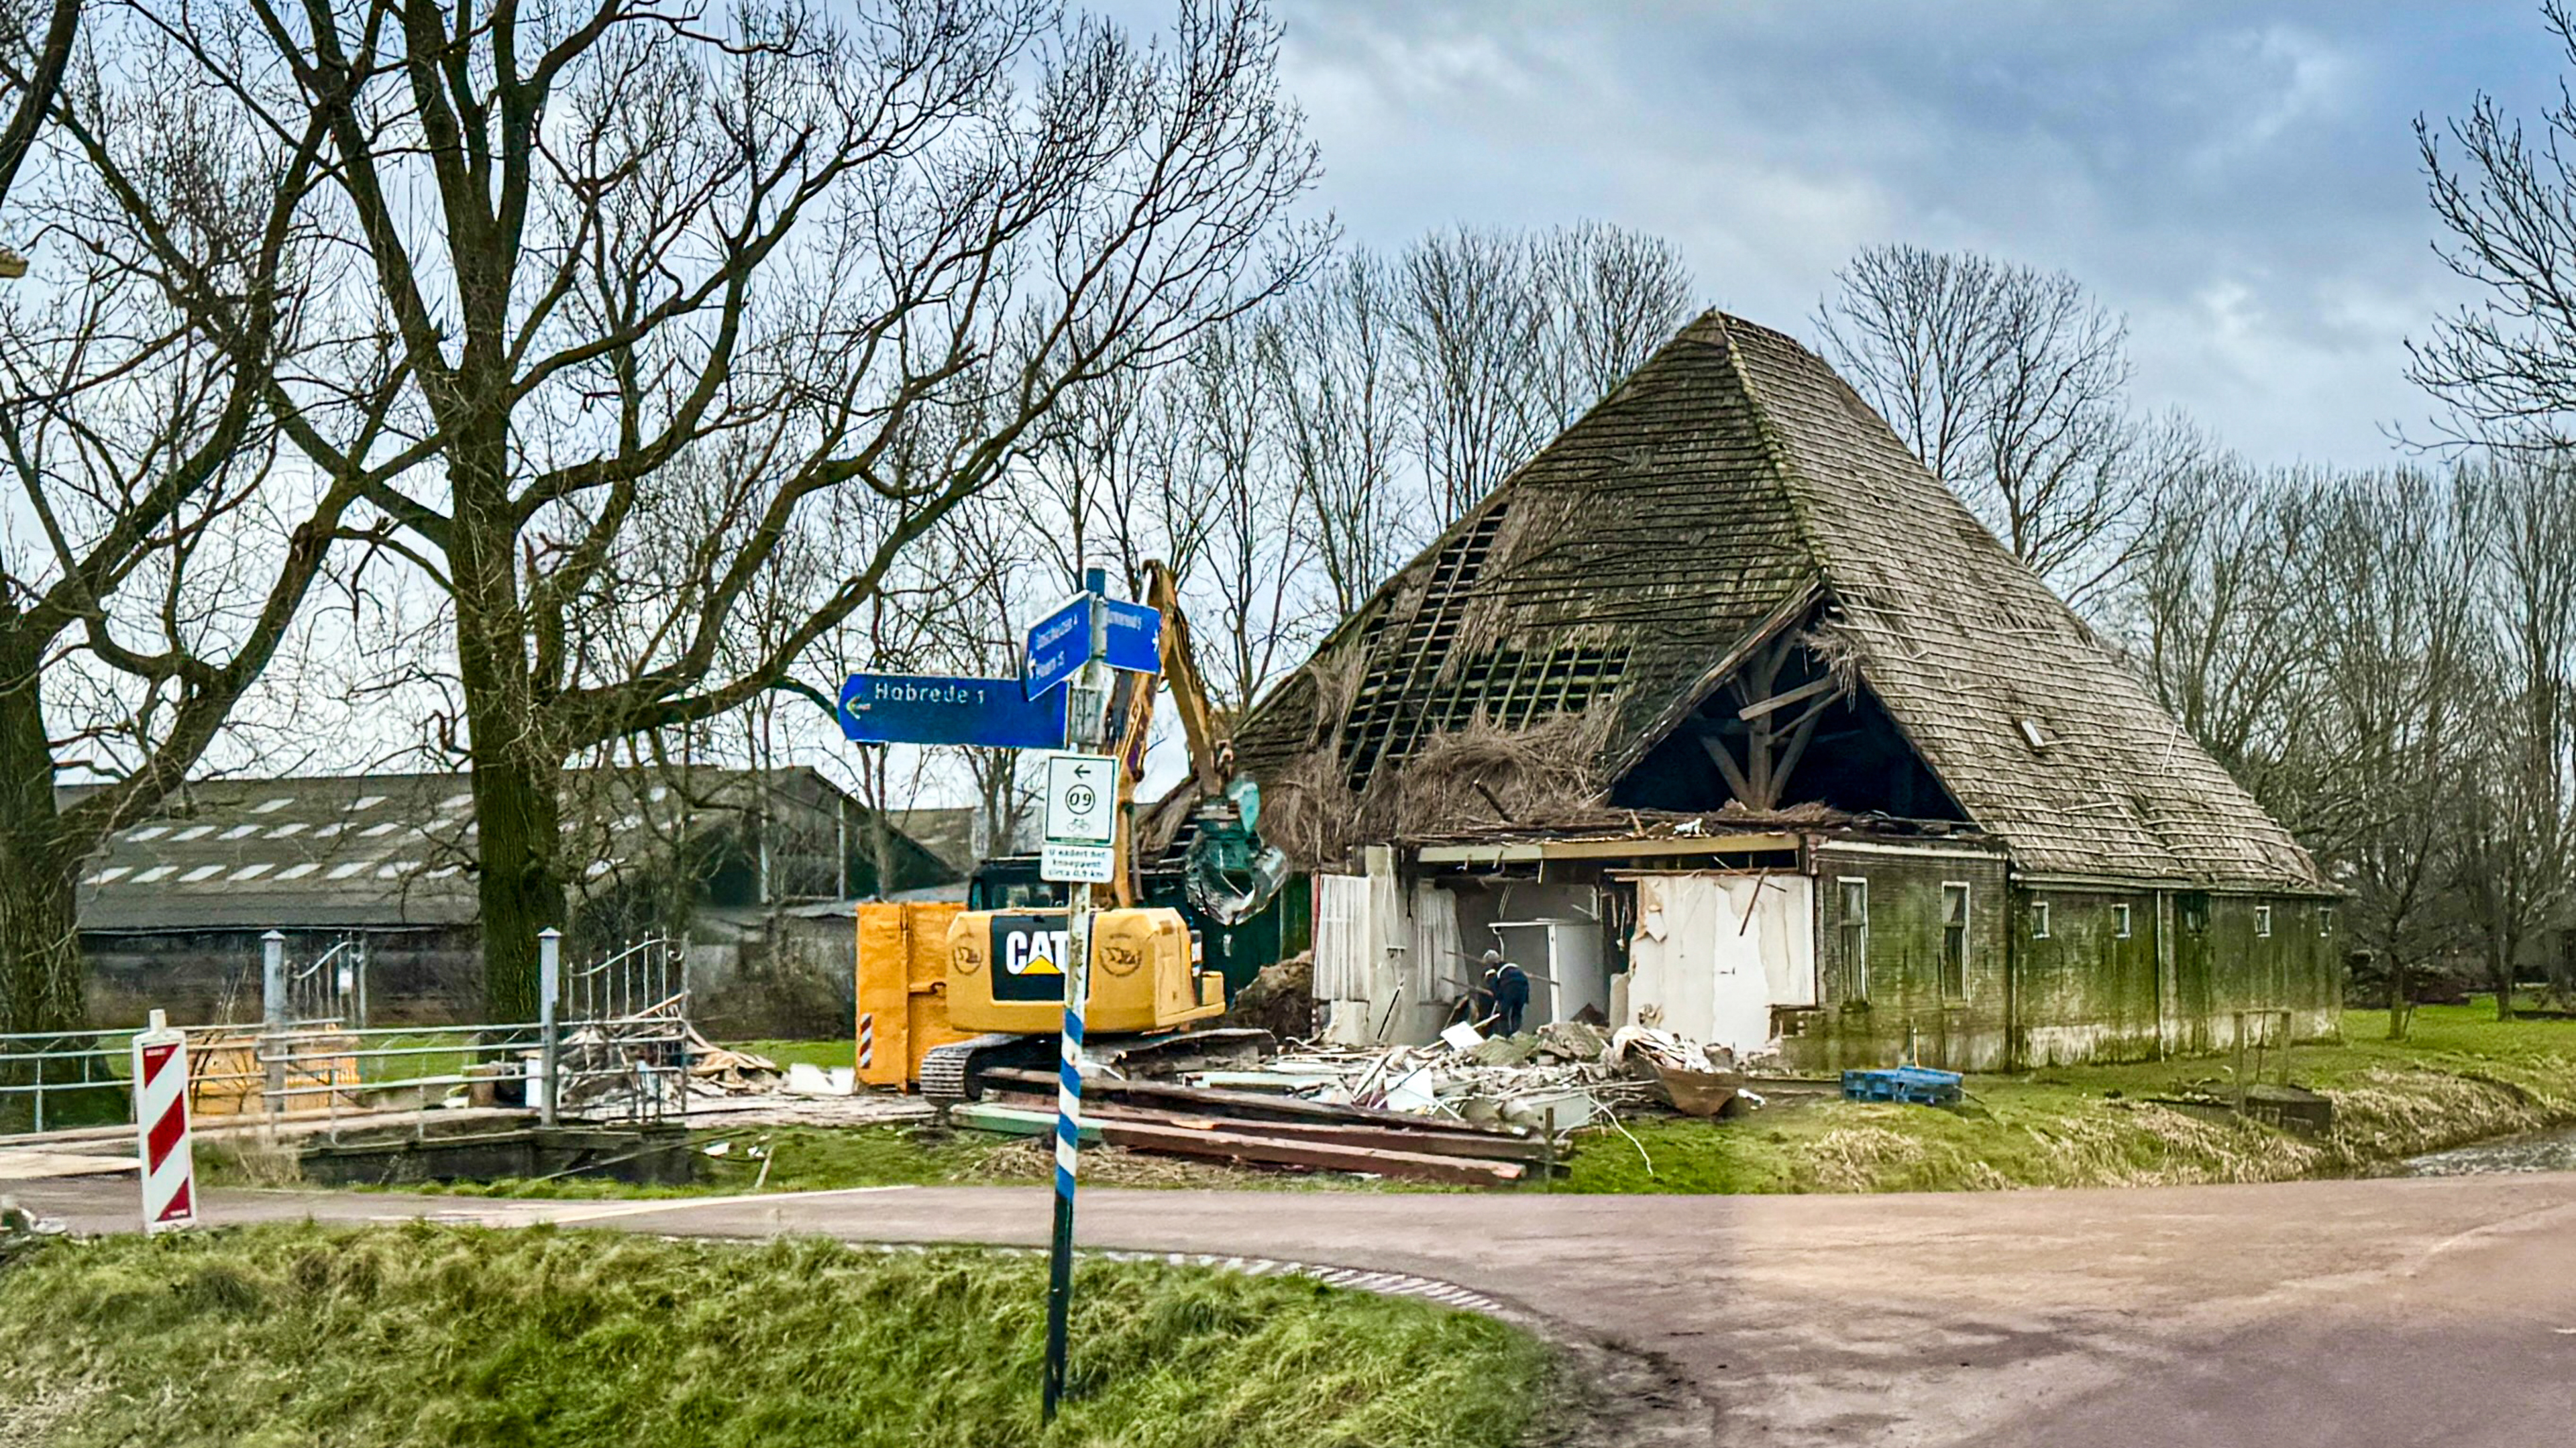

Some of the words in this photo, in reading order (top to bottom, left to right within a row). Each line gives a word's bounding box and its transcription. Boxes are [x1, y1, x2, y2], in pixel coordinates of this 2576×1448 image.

[977, 689, 984, 704] 1
[1069, 792, 1091, 806] 09
[1006, 931, 1068, 974] CAT
